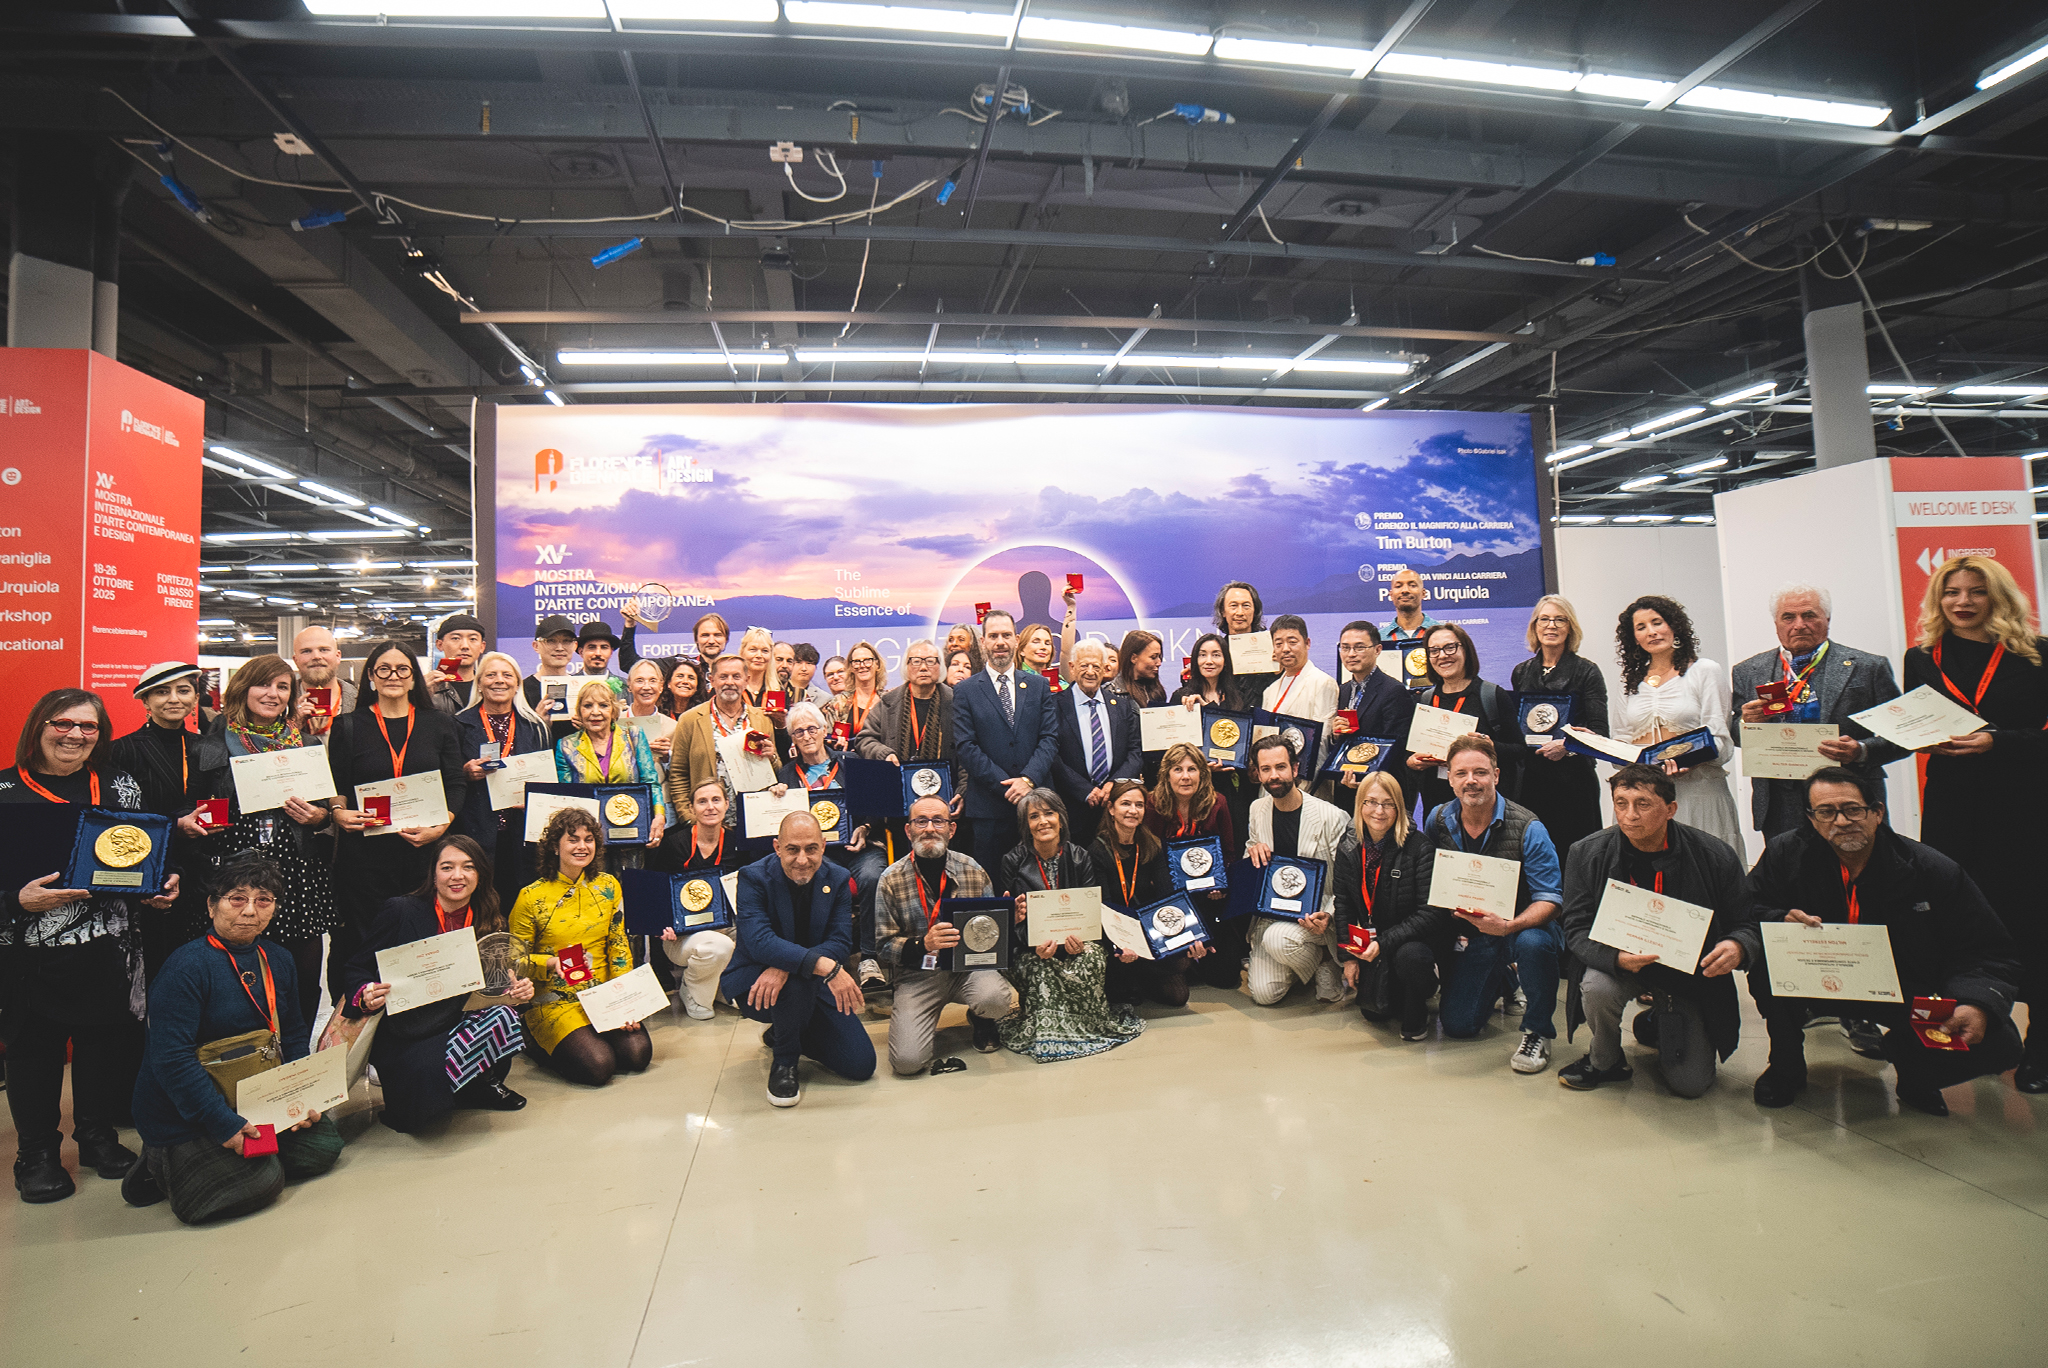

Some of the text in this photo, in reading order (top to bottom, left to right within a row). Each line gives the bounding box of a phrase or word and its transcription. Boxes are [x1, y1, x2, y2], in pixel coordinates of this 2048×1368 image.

[569, 456, 653, 471] FLORENCE
[569, 470, 653, 485] BIENNALE
[667, 469, 714, 483] DESIGN
[94, 488, 133, 507] MOSTRA
[94, 500, 165, 527] INTERNAZIONALE
[1908, 501, 2019, 516] WELCOME DESK
[1374, 511, 1404, 521] PREMIO
[94, 512, 195, 544] D'ARTE CONTEMPORANEA
[1374, 521, 1515, 531] LORENZO IL MAGNIFICO ALLA CARRIERA
[94, 525, 135, 543] E DESIGN
[1375, 535, 1452, 550] Tim Burton
[1946, 547, 1997, 559] INGRESSO
[93, 562, 118, 577] 18-26
[834, 568, 862, 581] The
[1377, 563, 1408, 572] PREMIO
[92, 574, 135, 591] OTTOBRE
[156, 573, 194, 588] FORTEZZA
[535, 569, 595, 582] MOSTRA
[1431, 572, 1452, 580] VINCI
[1452, 572, 1471, 580] ALLA
[1471, 571, 1508, 580] CARRIERA
[92, 587, 116, 601] 2025
[157, 584, 194, 599] DA BASSO
[834, 586, 891, 599] Sublime
[1434, 585, 1490, 603] Urquiola
[164, 597, 194, 610] FIRENZE
[535, 597, 584, 611] D'ARTE
[834, 603, 912, 617] Essence of
[535, 611, 601, 626] E SIGN
[92, 625, 147, 638] florencebiennale.org
